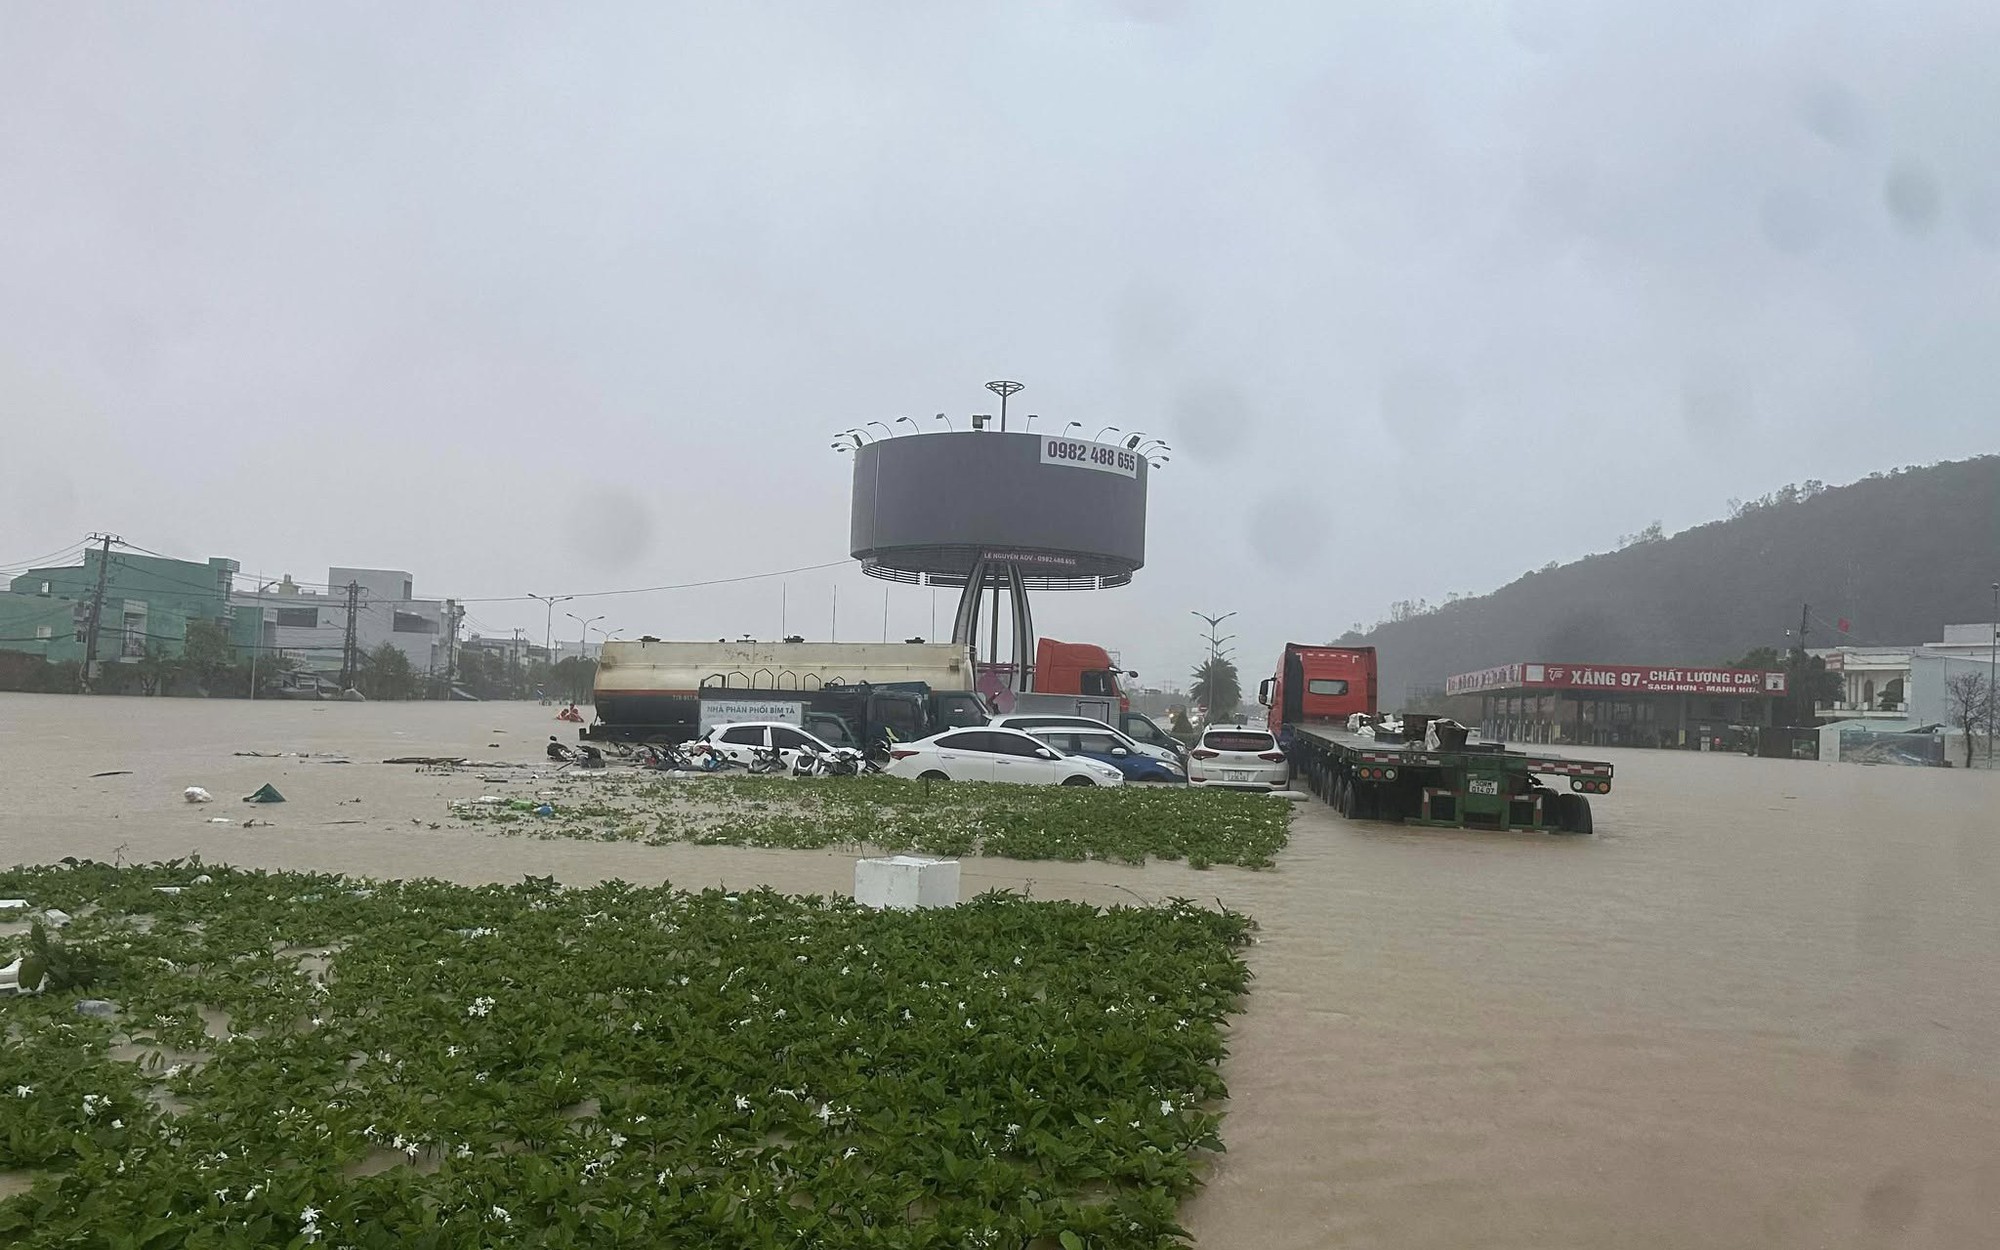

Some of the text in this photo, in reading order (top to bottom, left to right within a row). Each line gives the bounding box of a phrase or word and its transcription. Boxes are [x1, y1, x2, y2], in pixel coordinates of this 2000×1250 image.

[1047, 440, 1135, 471] 0982 488 655
[1571, 668, 1615, 686] XĂNG
[1649, 668, 1683, 682] CHẤT
[1687, 671, 1730, 684] LƯỢNG
[1648, 683, 1674, 693] SẠCH
